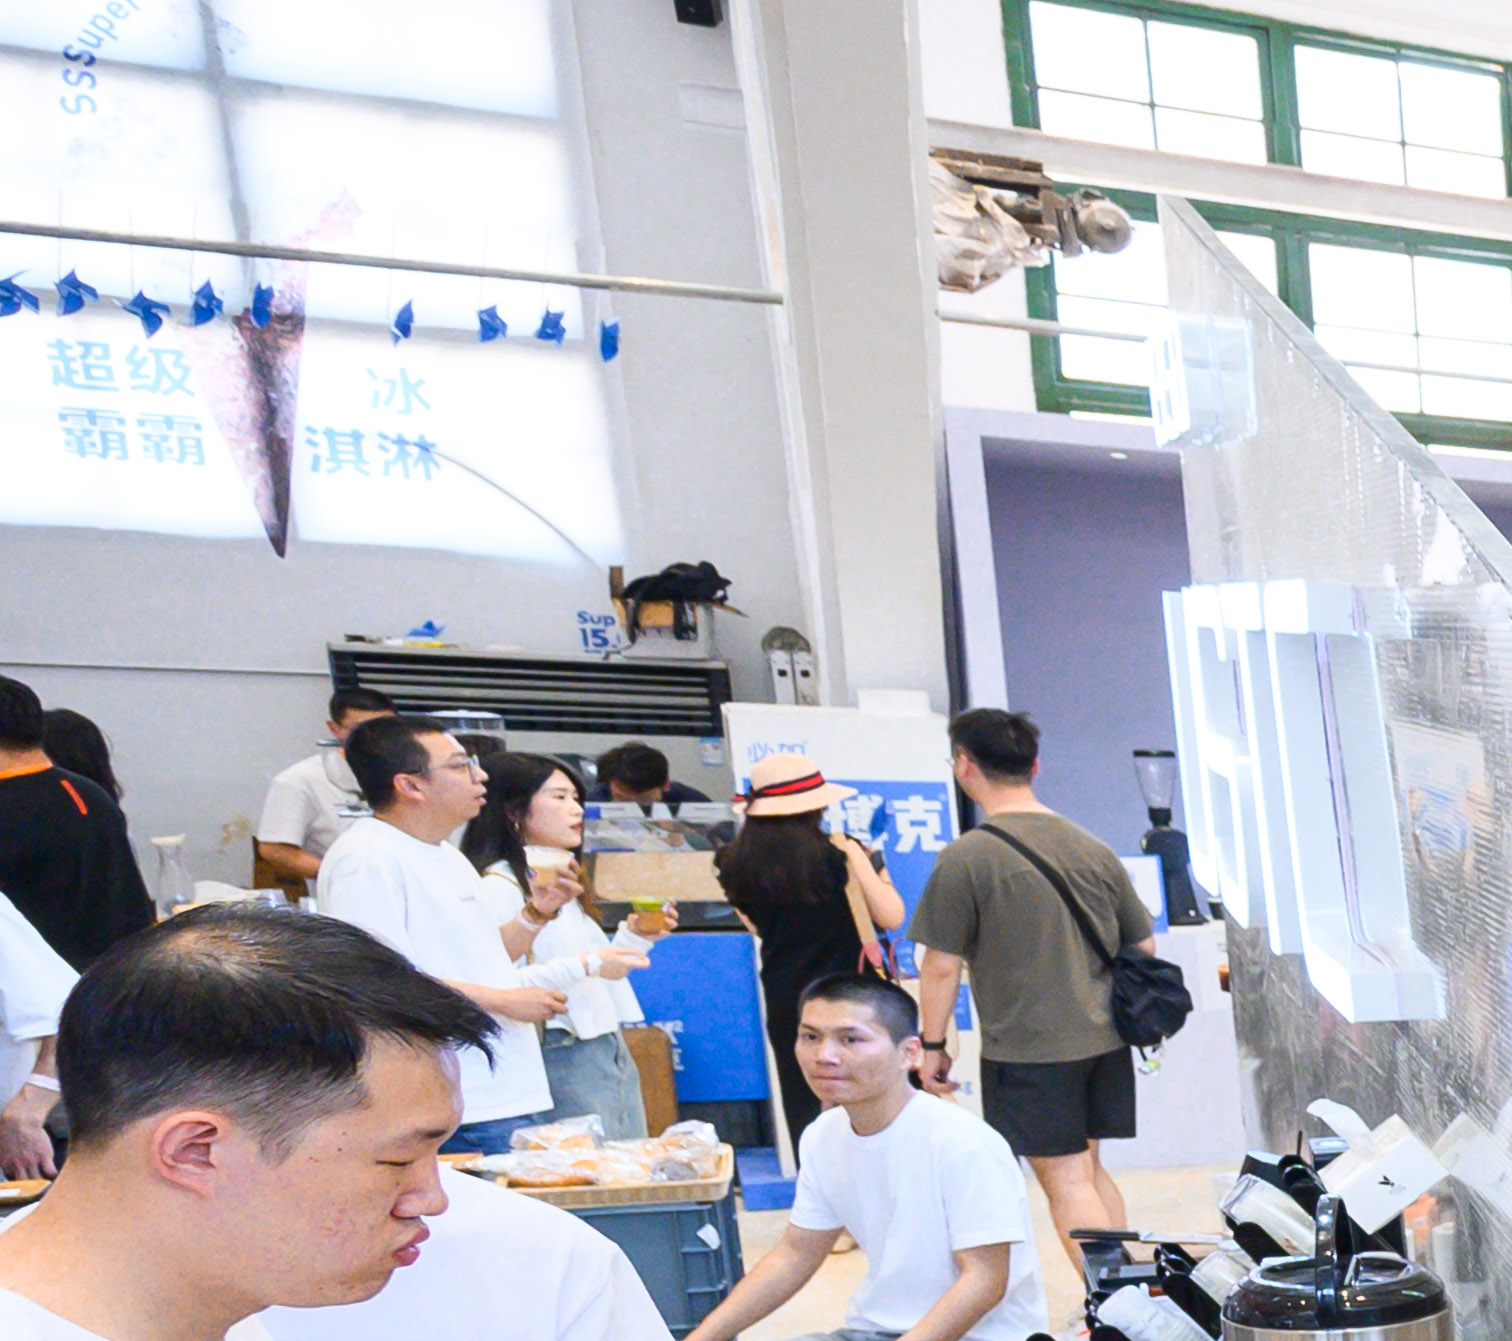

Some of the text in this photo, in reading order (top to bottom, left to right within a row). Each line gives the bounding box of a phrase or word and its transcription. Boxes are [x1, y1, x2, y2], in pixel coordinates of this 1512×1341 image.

[46, 338, 195, 397] 超级
[366, 367, 431, 415] 冰
[58, 407, 206, 465] 霸霸
[304, 426, 440, 481] 淇淋
